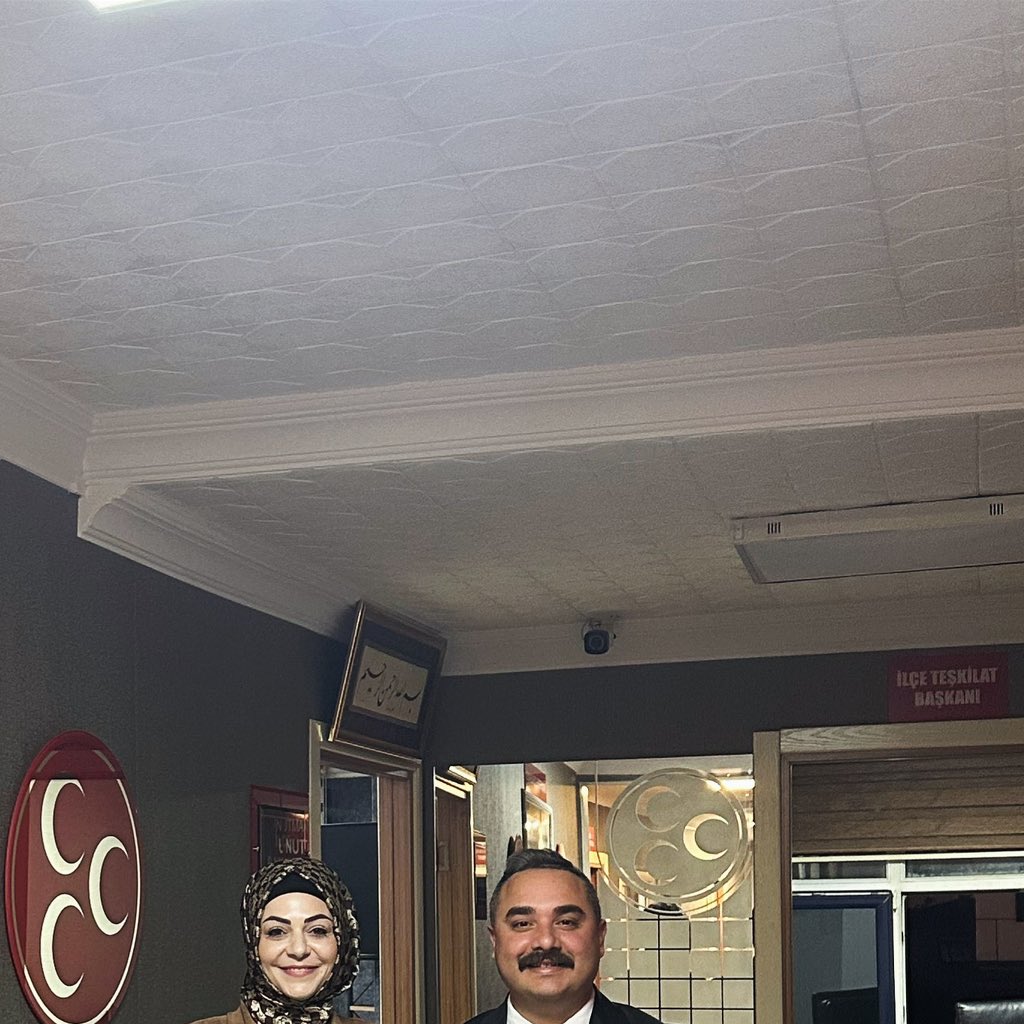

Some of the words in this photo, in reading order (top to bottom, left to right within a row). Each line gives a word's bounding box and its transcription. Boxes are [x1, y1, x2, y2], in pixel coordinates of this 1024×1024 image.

[897, 670, 927, 689] İLÇE
[932, 666, 997, 687] TEŞKİLAT
[915, 690, 980, 708] BAŞKANI
